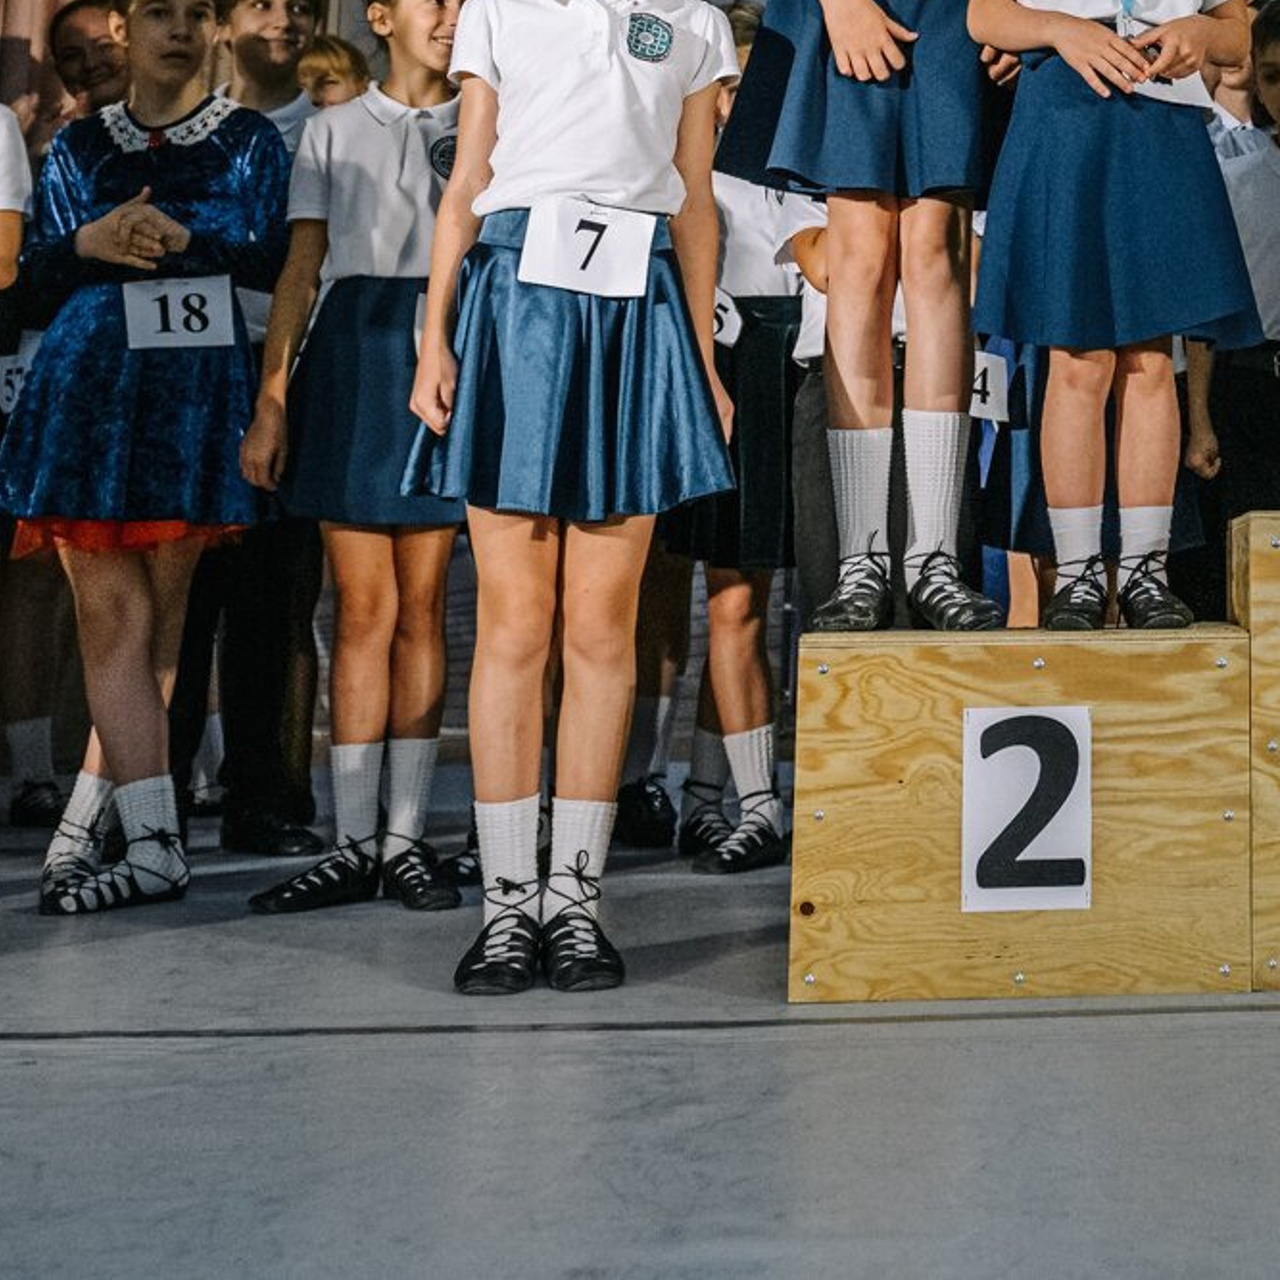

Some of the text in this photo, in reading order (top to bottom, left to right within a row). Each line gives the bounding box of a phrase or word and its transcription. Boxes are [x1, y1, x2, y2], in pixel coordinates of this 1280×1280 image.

[575, 218, 608, 271] 7
[152, 293, 209, 334] 18
[976, 715, 1086, 888] 2
